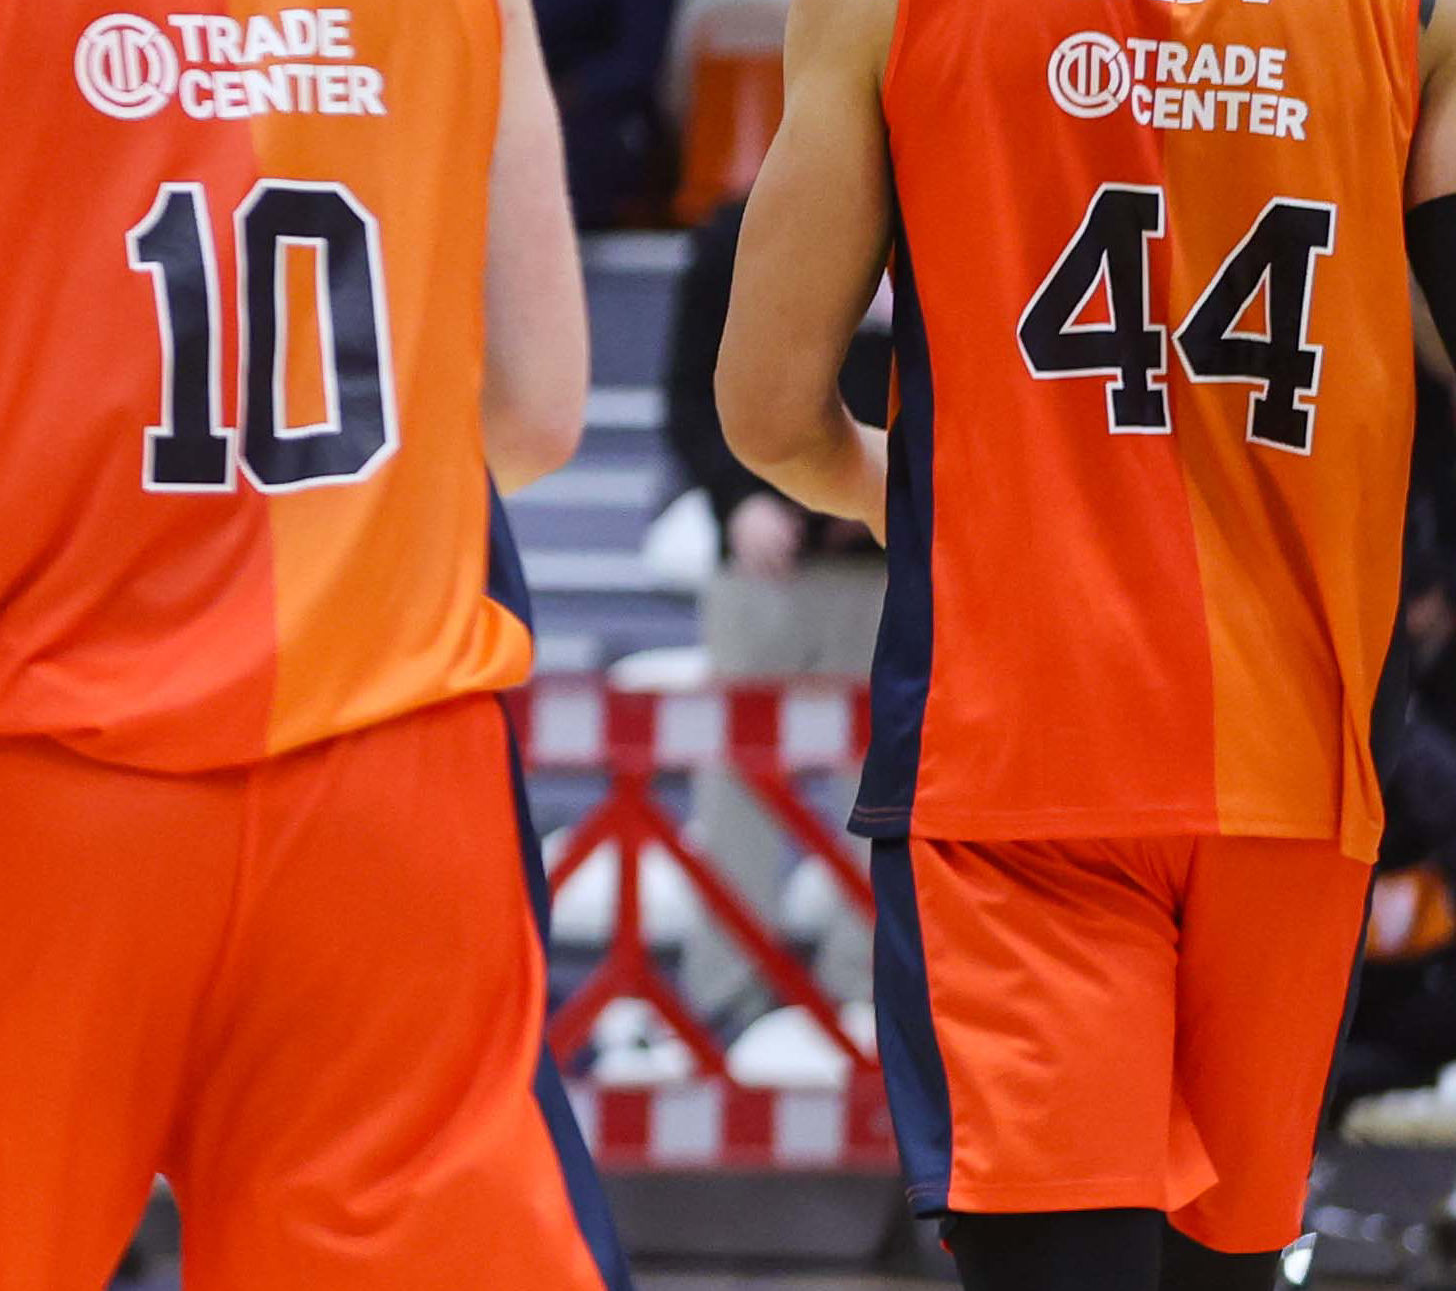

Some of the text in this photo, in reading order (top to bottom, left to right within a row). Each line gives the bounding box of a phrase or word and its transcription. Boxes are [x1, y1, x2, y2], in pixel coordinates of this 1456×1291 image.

[167, 8, 356, 66] TRADE
[1125, 36, 1287, 91] TRADE
[178, 63, 388, 121] CENTER
[1130, 87, 1310, 142] CENTER
[125, 177, 402, 494] 10
[1015, 181, 1338, 457] 44
